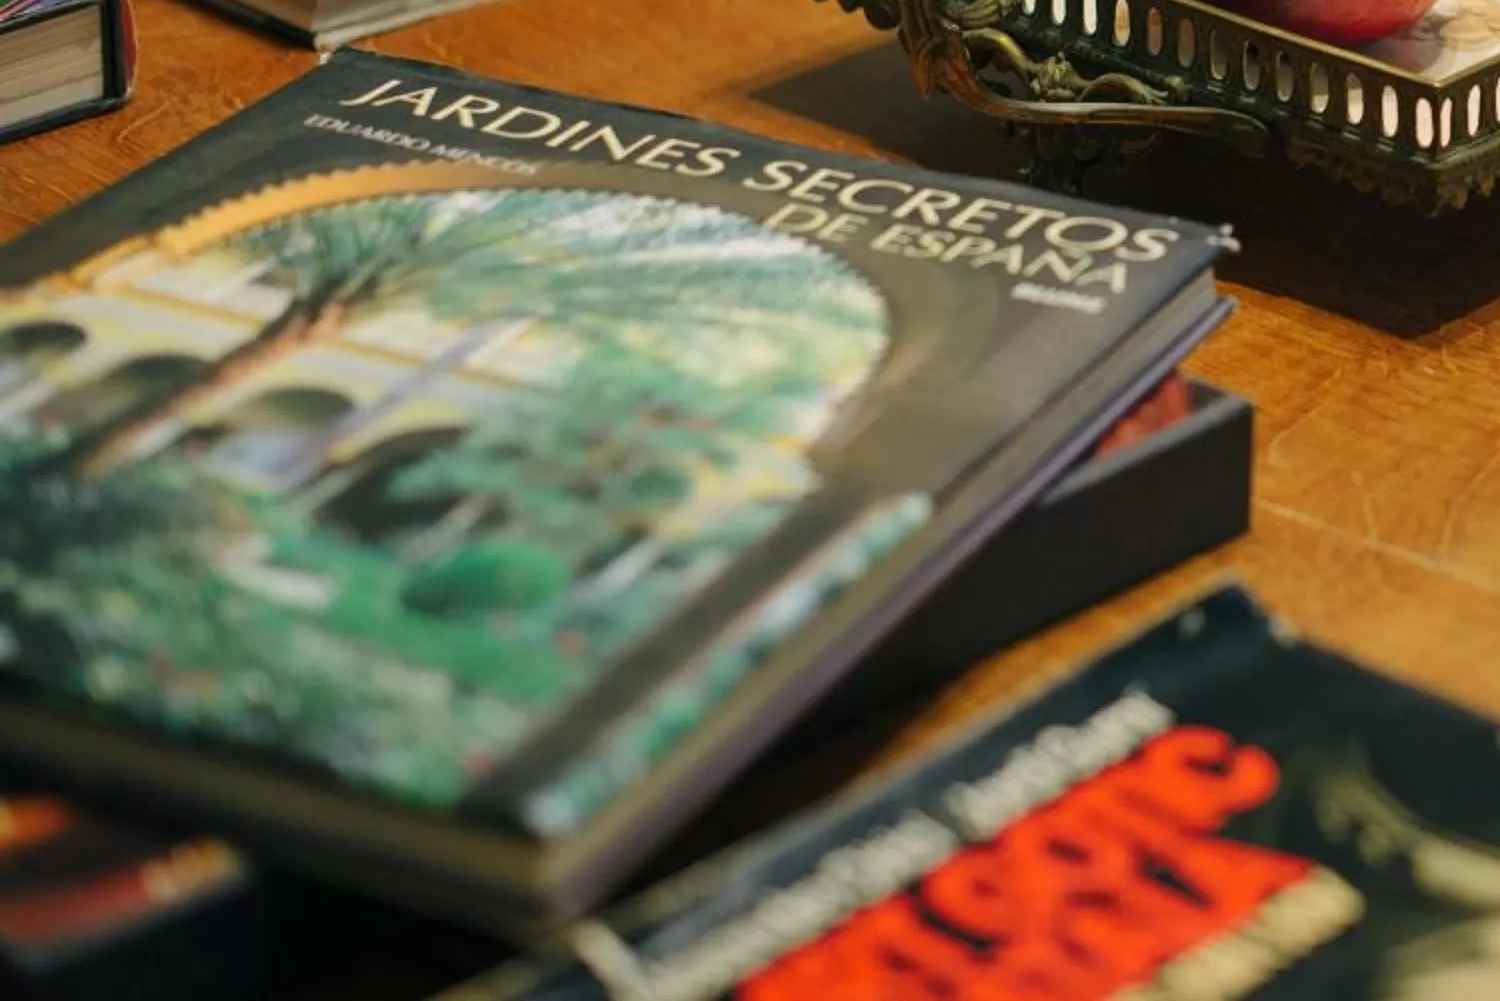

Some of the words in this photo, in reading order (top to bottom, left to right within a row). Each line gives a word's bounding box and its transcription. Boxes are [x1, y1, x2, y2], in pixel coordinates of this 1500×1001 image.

[303, 112, 431, 151] EDUARDO
[338, 78, 740, 178] JARDINES
[742, 159, 1181, 262] SECRETOS
[763, 202, 870, 244] DE
[870, 223, 1128, 294] ESPAÑA
